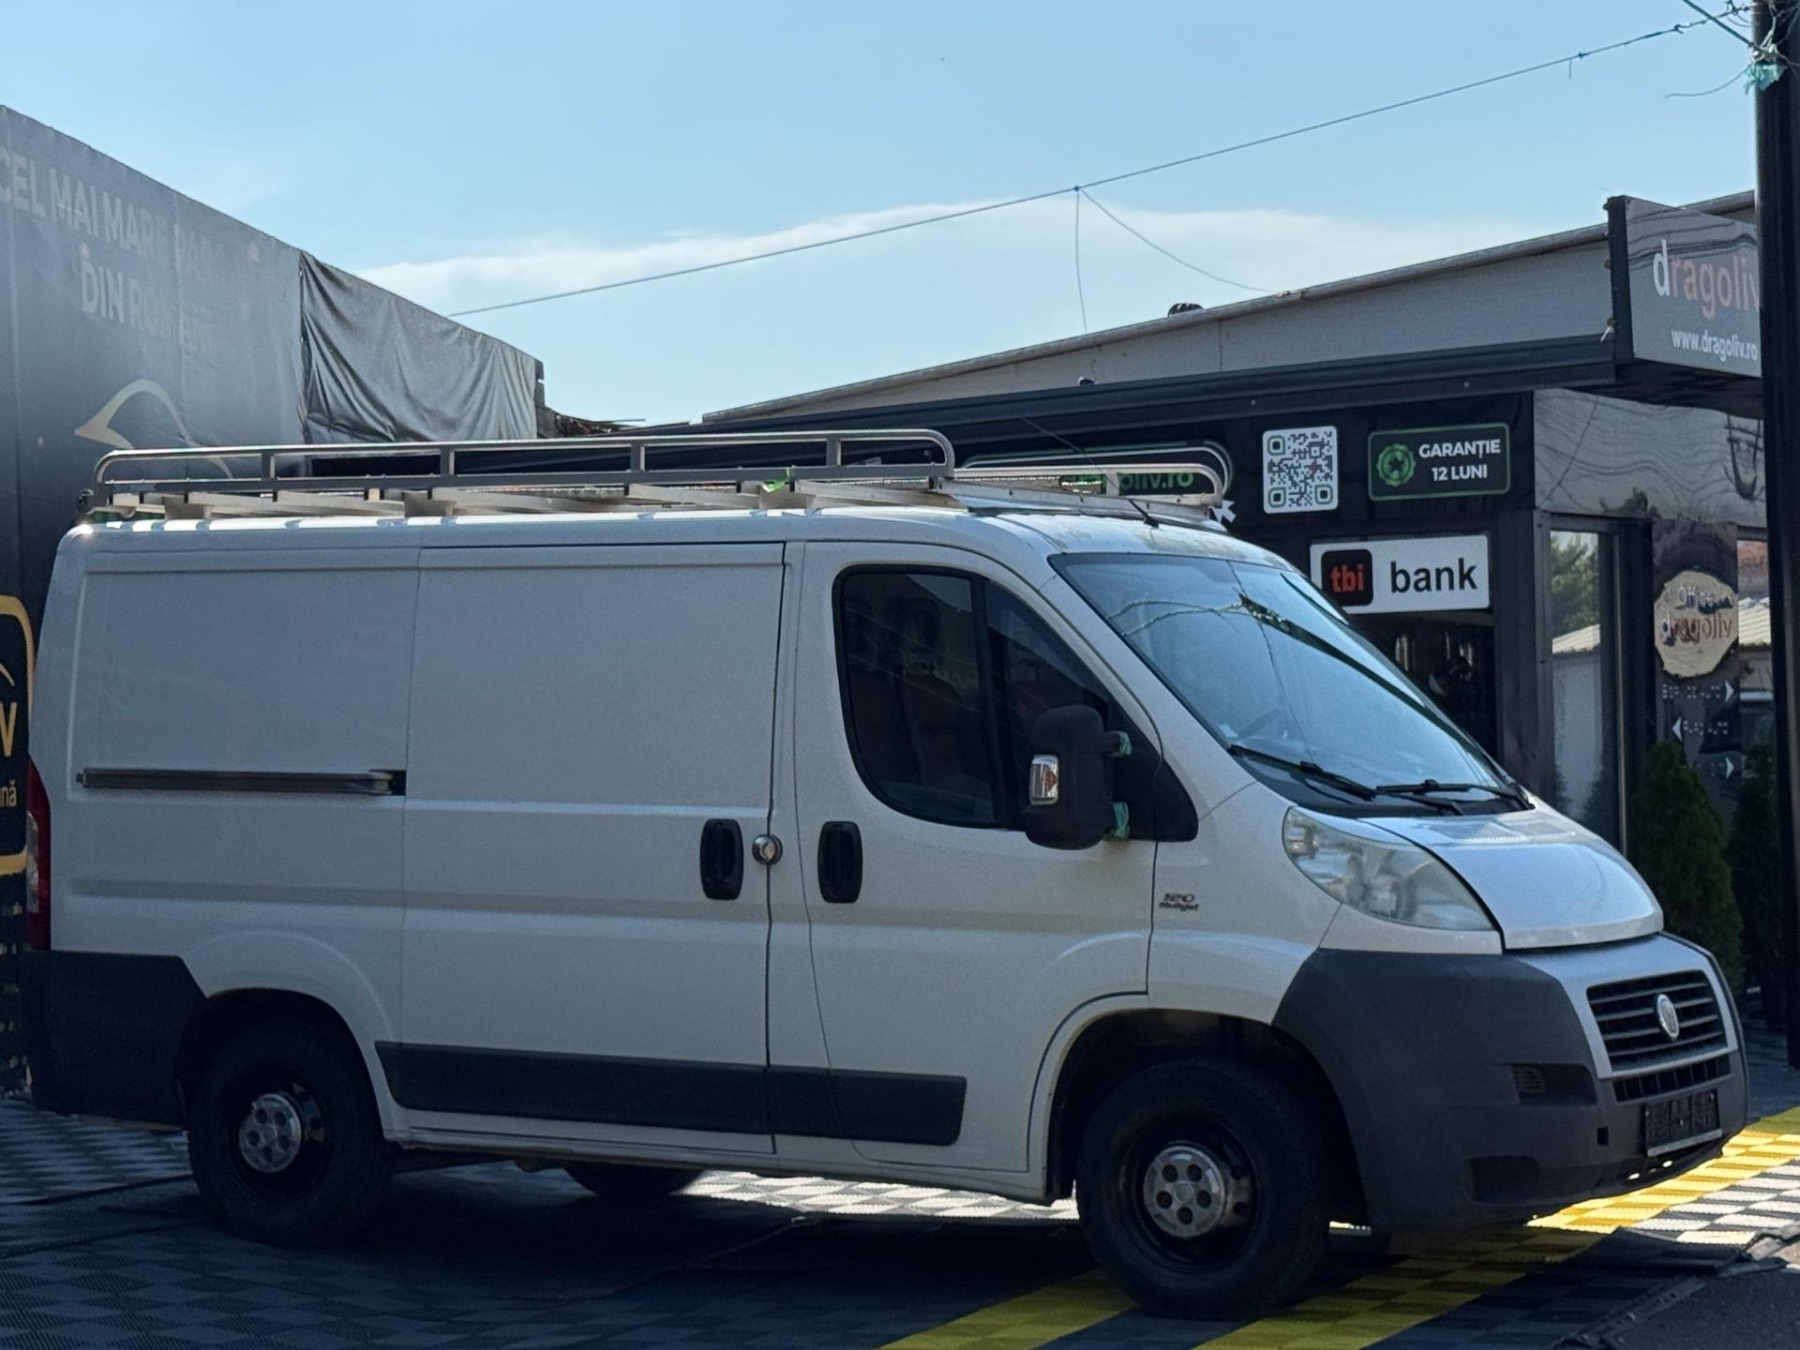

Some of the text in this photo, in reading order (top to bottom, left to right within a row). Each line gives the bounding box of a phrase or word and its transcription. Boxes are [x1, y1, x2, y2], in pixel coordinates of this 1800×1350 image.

[0, 145, 46, 217] CEL
[49, 168, 98, 237] MAI
[81, 258, 124, 324] DIN
[1671, 328, 1758, 362] www.dragoliv.ro
[1432, 464, 1488, 482] 12 LUNI
[1330, 557, 1478, 593] tbi bank
